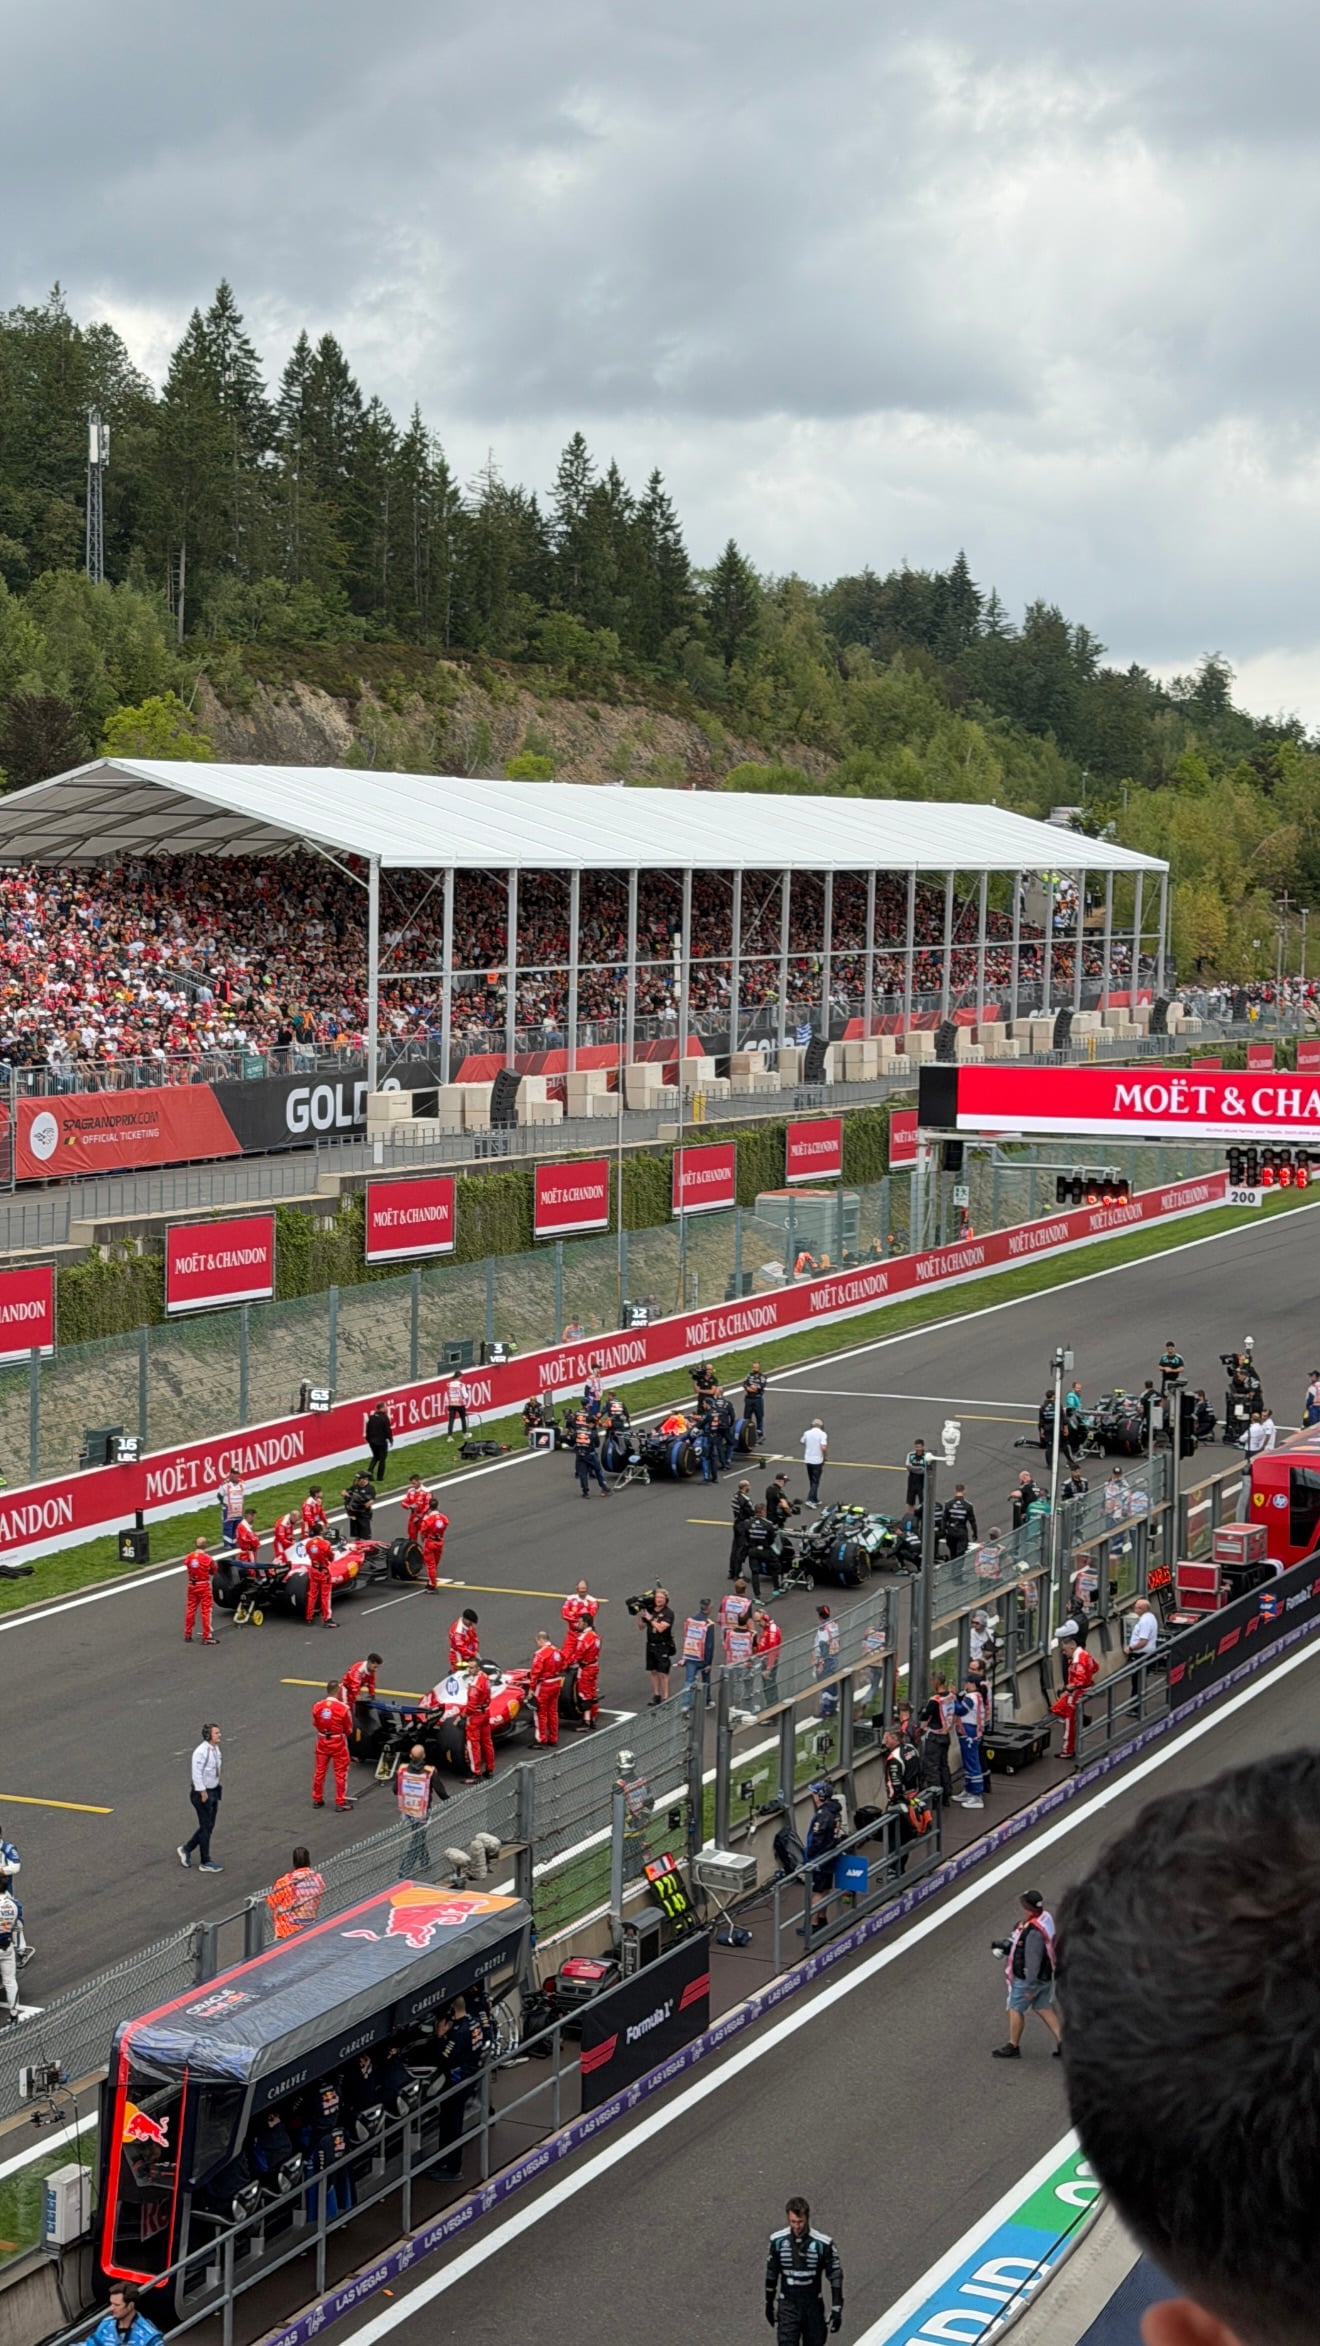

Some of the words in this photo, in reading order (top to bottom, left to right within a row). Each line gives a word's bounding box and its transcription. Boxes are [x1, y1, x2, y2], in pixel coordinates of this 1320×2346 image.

[1113, 1078, 1216, 1114] MOËT
[1221, 1086, 1246, 1116] &
[1251, 1087, 1320, 1118] CHA
[63, 1111, 159, 1132] SPAGRANDPRIX.COM
[82, 1132, 119, 1145] OFFICIAL
[120, 1128, 160, 1141] TICKETING
[678, 1169, 698, 1187] OËT
[540, 1186, 562, 1205] MOËT
[569, 1184, 604, 1202] CHANDON
[1231, 1191, 1256, 1204] 200
[373, 1207, 398, 1228] MOËT
[407, 1204, 449, 1223] CHANDON
[1035, 1222, 1069, 1247] CHANDON
[175, 1251, 208, 1275] MOËT
[208, 1253, 215, 1270] &
[216, 1246, 267, 1268] CHANDON
[915, 1255, 941, 1281] MOËT
[947, 1245, 985, 1273] CHANDON
[809, 1284, 837, 1312] MOËT
[838, 1286, 845, 1304] &
[845, 1272, 889, 1302] CHANDON
[0, 1299, 46, 1324] ANDON
[631, 1308, 648, 1318] 12
[685, 1316, 717, 1348] MOËT
[718, 1318, 727, 1339] &
[727, 1304, 778, 1336] CHANDON
[490, 1355, 506, 1363] VER
[493, 1343, 503, 1354] 3
[539, 1354, 576, 1387] MOËT
[577, 1355, 587, 1377] &
[587, 1339, 647, 1374] CHANDON
[309, 1402, 329, 1411] RUS
[310, 1389, 329, 1400] 63
[421, 1380, 492, 1420] CHAON
[117, 1438, 137, 1450] 16
[117, 1452, 137, 1462] LEC
[145, 1458, 200, 1501] MOËT
[203, 1457, 216, 1483] &
[218, 1430, 305, 1480] CHANDON
[0, 1494, 73, 1543] ANDON
[122, 1546, 135, 1558] 16
[821, 1951, 834, 1966] LAS
[411, 1987, 447, 2015] CARLYLE
[768, 1987, 781, 2005] LAS
[626, 2007, 664, 2045] Formula
[710, 2028, 723, 2046] LAS
[723, 2014, 745, 2036] VEGAS
[339, 2029, 375, 2058] CARLYLE
[267, 2069, 308, 2100] CARLYLE
[648, 2072, 662, 2090] LAS
[662, 2056, 685, 2079] VEGAS
[579, 2119, 595, 2139] LAS
[595, 2103, 621, 2127] VEGAS
[505, 2170, 522, 2191] LAS
[522, 2151, 550, 2179] VEGAS
[424, 2227, 443, 2248] LAS
[443, 2206, 473, 2235] VEGAS
[335, 2288, 355, 2311] LAS
[355, 2266, 388, 2297] VEGAS
